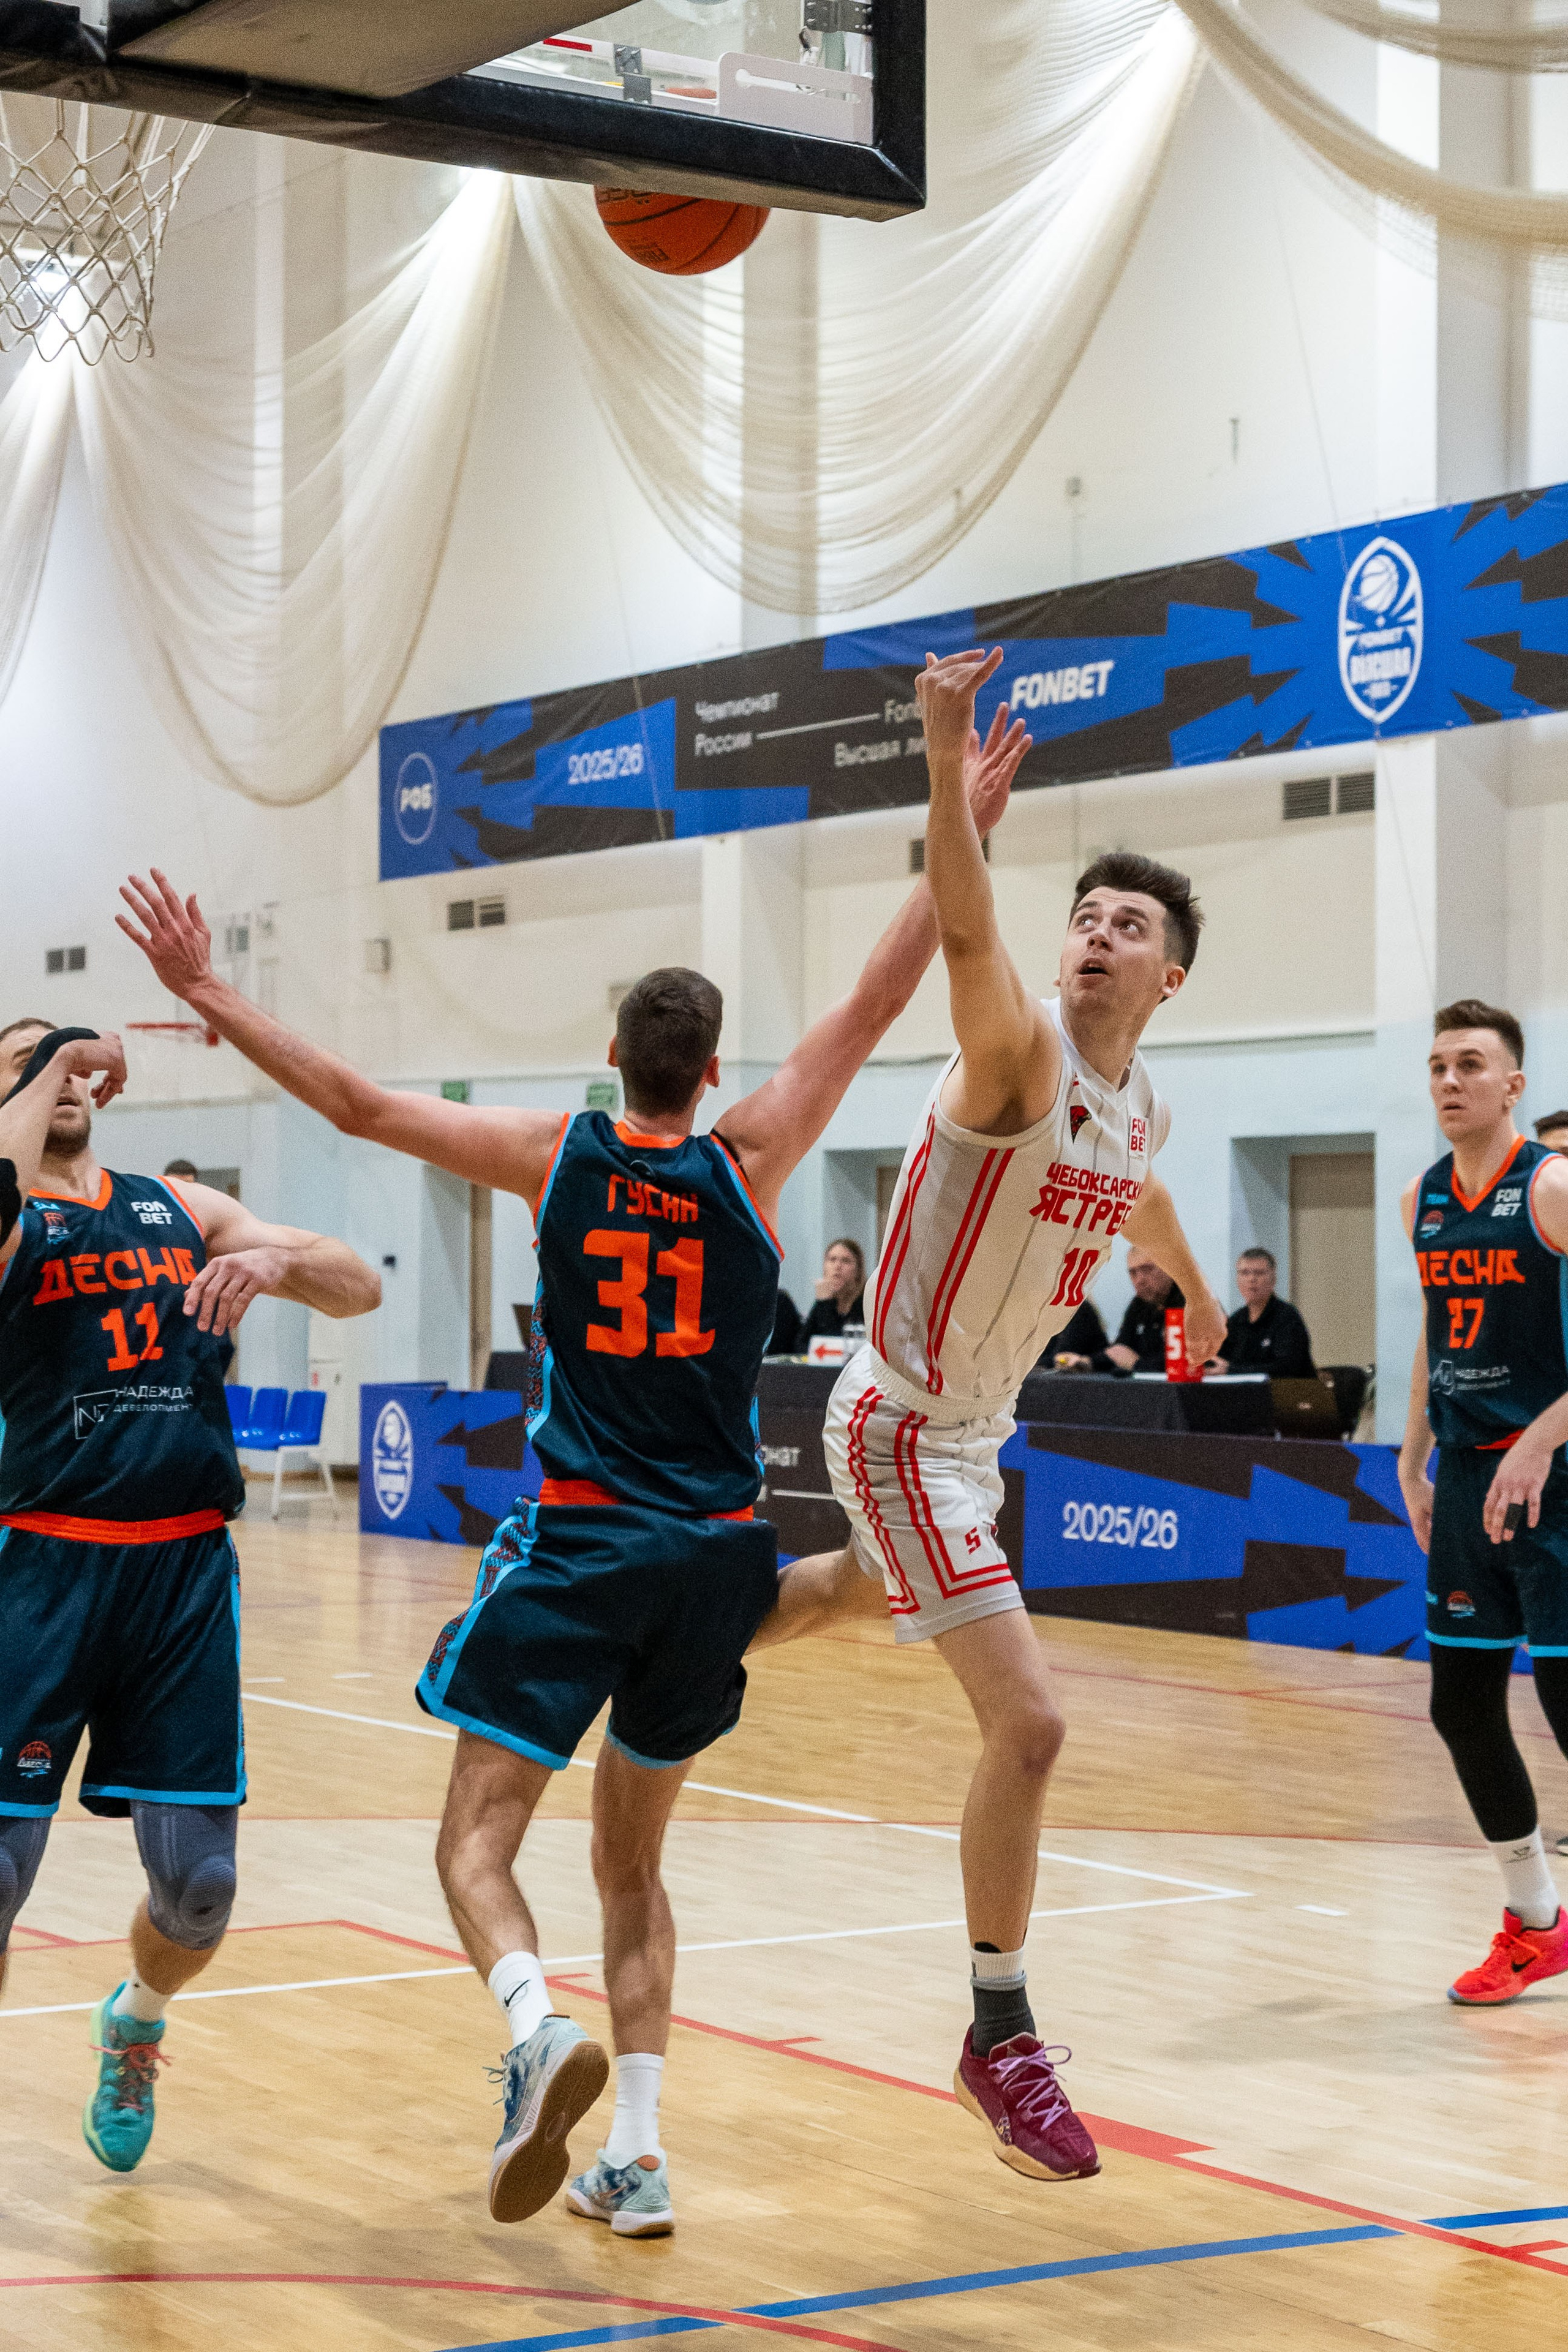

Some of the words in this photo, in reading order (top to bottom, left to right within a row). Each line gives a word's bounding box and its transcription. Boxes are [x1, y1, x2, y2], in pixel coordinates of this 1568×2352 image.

[1011, 659, 1116, 712] FONBET
[567, 742, 644, 785] 2025/26
[695, 731, 754, 757] России
[834, 740, 902, 769] Высшая
[138, 1212, 173, 1225] BET
[1490, 1202, 1523, 1218] BET
[1494, 1188, 1523, 1204] FON
[33, 1246, 198, 1306] ДЕСНА
[582, 1228, 716, 1359] 31
[1049, 1247, 1099, 1307] 10
[101, 1302, 164, 1372] 11
[1446, 1297, 1485, 1349] 27
[115, 1385, 194, 1400] НАДЕЖДА
[1061, 1501, 1178, 1550] 2025/26
